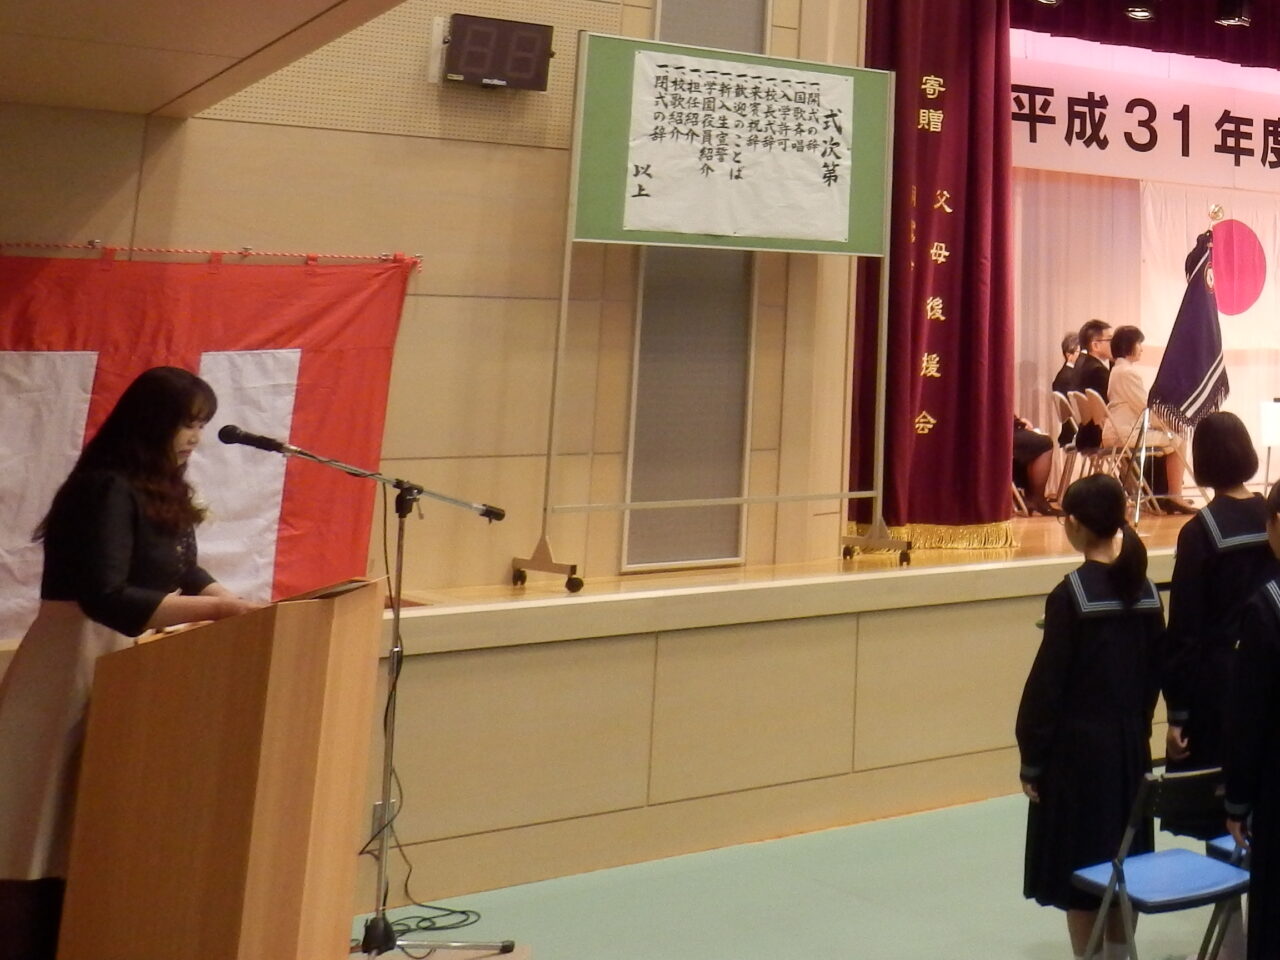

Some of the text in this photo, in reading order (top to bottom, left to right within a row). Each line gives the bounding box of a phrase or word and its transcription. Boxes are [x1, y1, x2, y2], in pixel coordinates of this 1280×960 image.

[917, 74, 946, 132] 寄贈
[631, 164, 653, 198] 以上
[821, 108, 843, 187] 式次第
[914, 188, 953, 434] 父母後援会
